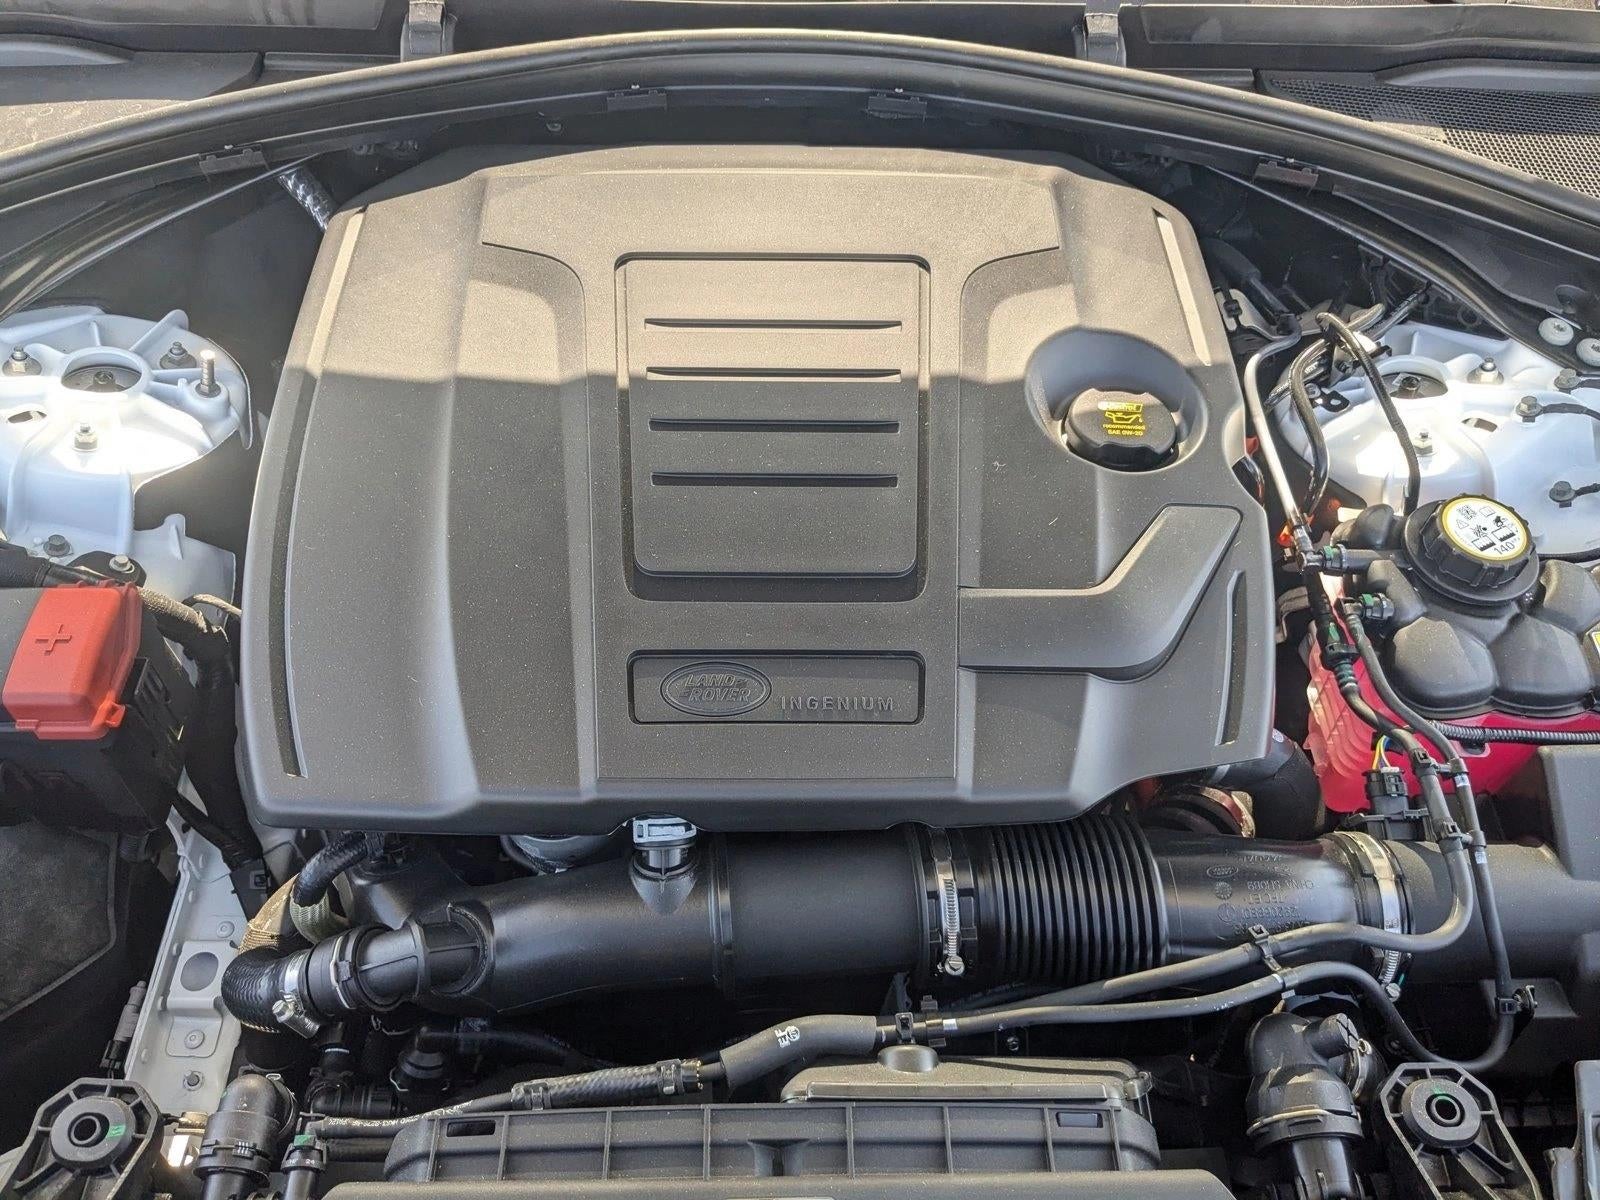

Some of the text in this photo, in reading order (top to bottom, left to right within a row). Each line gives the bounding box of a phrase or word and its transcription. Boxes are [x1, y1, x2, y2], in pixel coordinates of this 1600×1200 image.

[1494, 541, 1516, 555] 140
[684, 673, 737, 688] LAND
[687, 687, 752, 702] ROVER
[779, 695, 895, 711] INGENIUM
